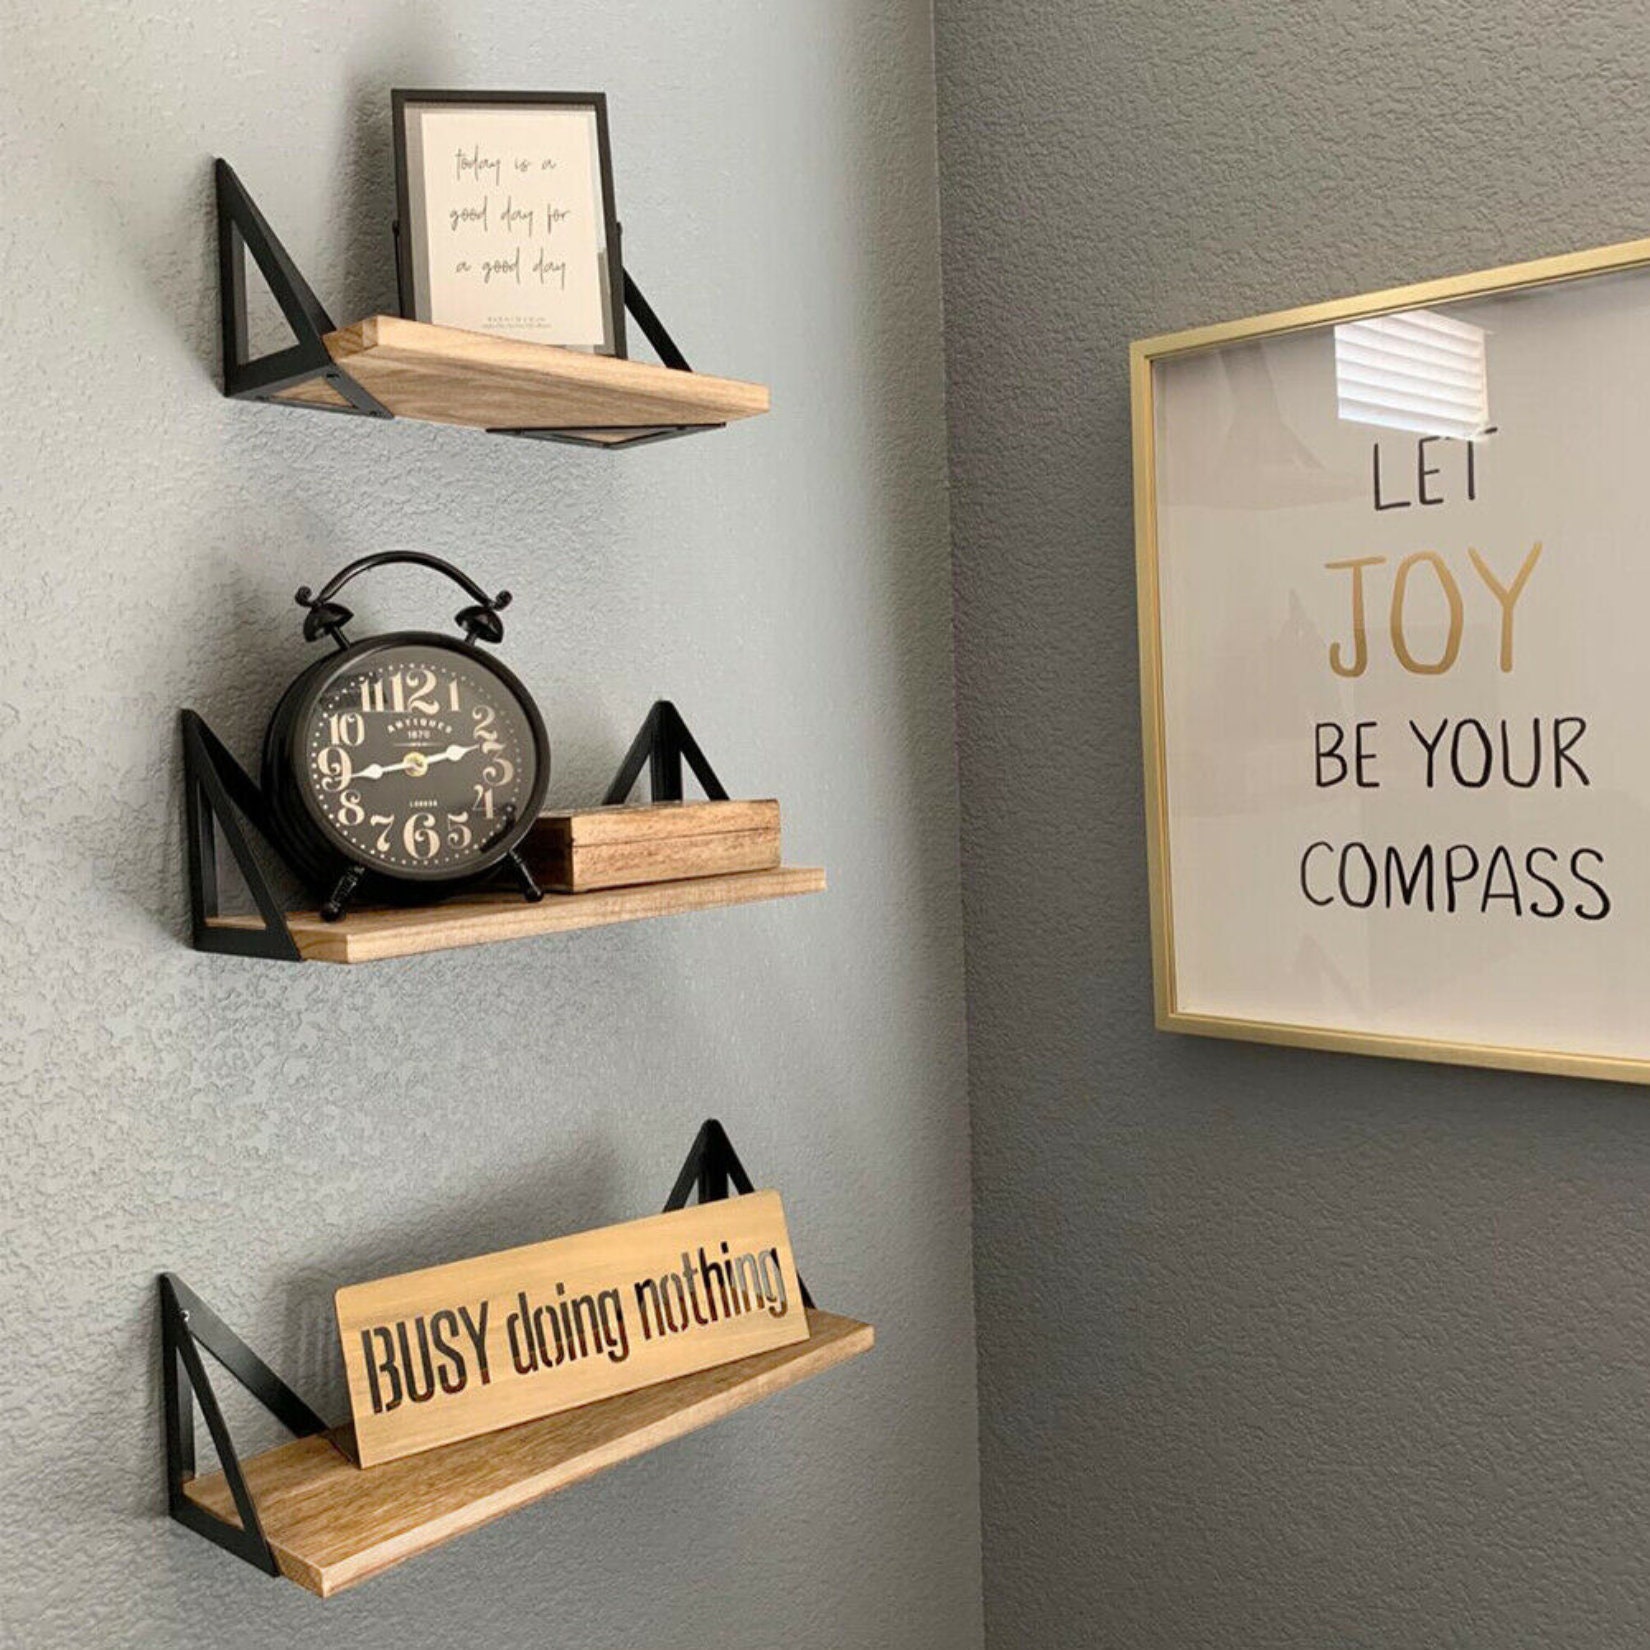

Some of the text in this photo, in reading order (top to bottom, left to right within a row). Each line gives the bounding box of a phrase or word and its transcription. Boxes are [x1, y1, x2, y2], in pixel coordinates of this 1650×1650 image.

[454, 145, 556, 186] today is a
[449, 195, 571, 237] good day for
[455, 246, 567, 291] a good day
[1373, 427, 1498, 511] LET
[1325, 541, 1543, 678] JOY
[360, 678, 385, 713] 11
[391, 669, 440, 715] 12
[449, 678, 461, 712] 1
[329, 712, 365, 747] 10
[472, 705, 498, 741] 2
[317, 746, 352, 793] 9
[481, 742, 514, 787] 3
[1314, 717, 1590, 788] BE YOUR
[338, 789, 365, 826] 8
[472, 784, 496, 819] 4
[370, 814, 395, 852] 7
[403, 812, 440, 860] 6
[448, 811, 472, 849] 5
[1300, 842, 1611, 920] COMPASS
[360, 1241, 789, 1415] BUSY doing nothing
